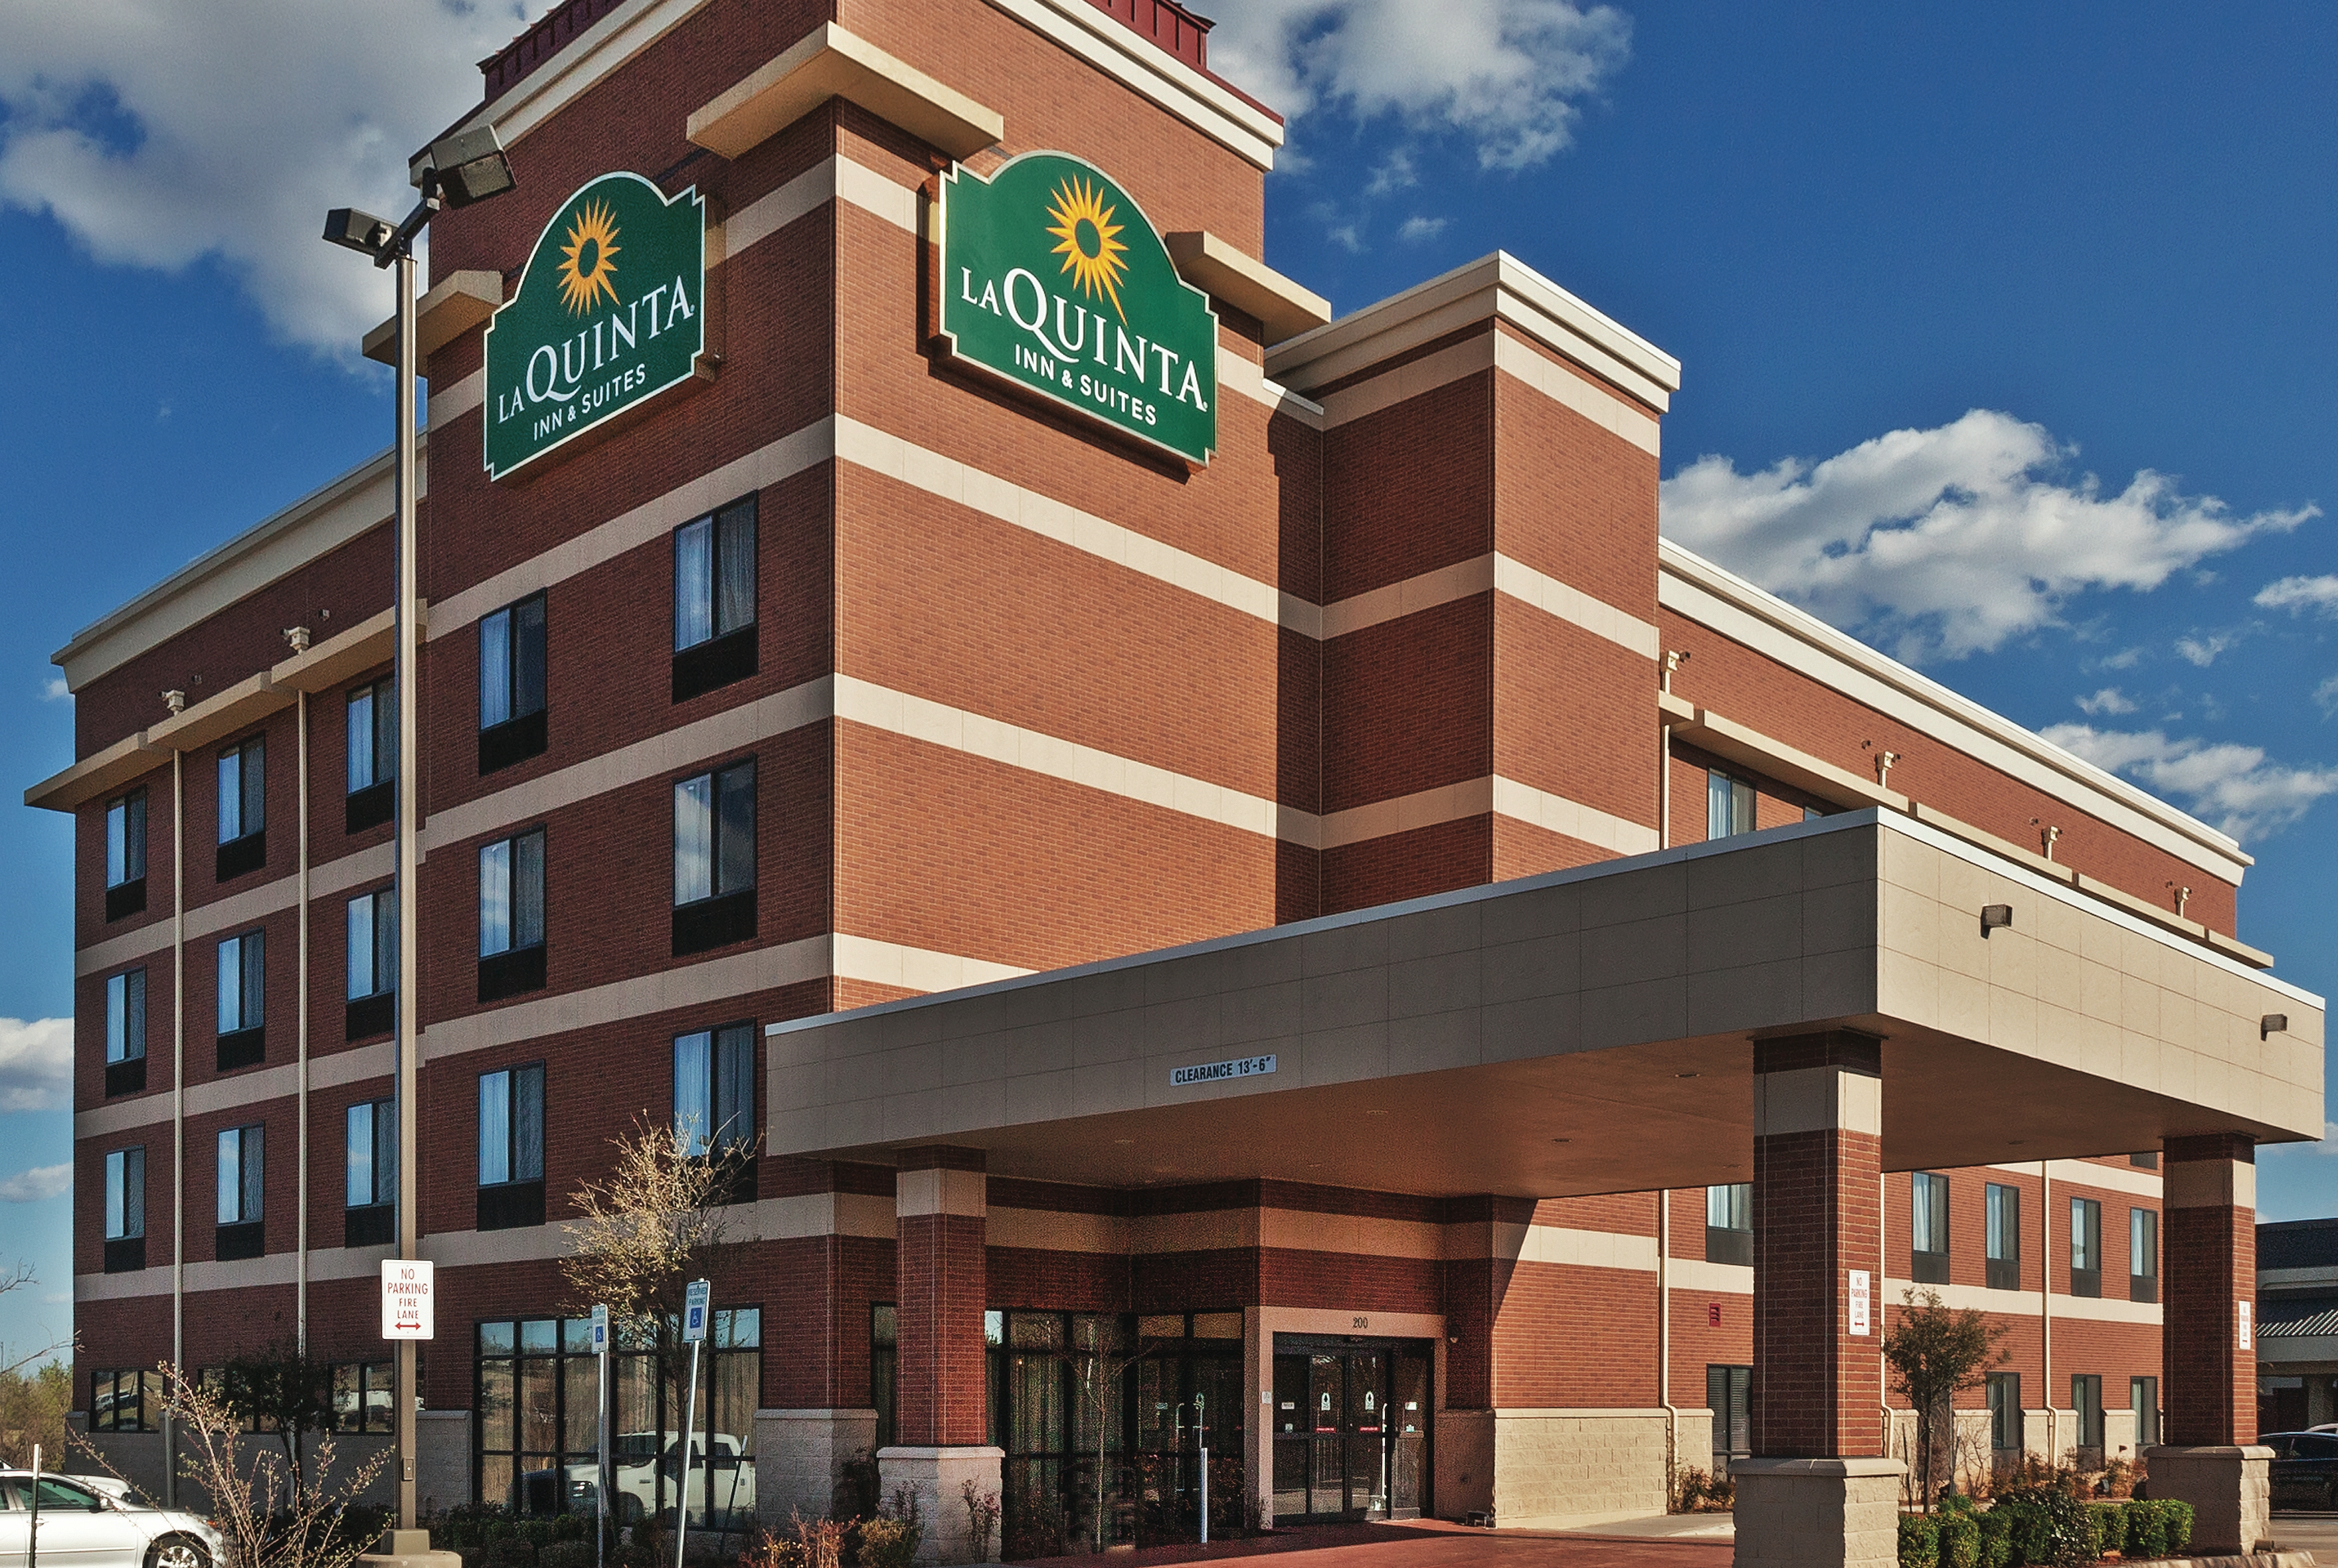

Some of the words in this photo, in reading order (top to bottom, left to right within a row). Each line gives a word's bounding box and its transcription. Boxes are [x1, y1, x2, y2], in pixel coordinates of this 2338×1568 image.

[961, 267, 1002, 317] LA
[1004, 268, 1208, 412] QUINTA
[497, 386, 525, 423] LA
[526, 275, 693, 402] QUINTA
[1015, 344, 1055, 381] INN
[1061, 370, 1073, 389] &
[1080, 375, 1156, 425] SUITES
[533, 408, 562, 441] INN
[567, 405, 577, 422] &
[581, 363, 646, 414] SUITES
[1175, 1063, 1233, 1083] CLEARANCE
[401, 1268, 414, 1280] NO
[387, 1282, 428, 1294] PARKING
[399, 1298, 417, 1307] FIRE
[397, 1310, 418, 1319] LANE
[1353, 1316, 1368, 1328] 200
